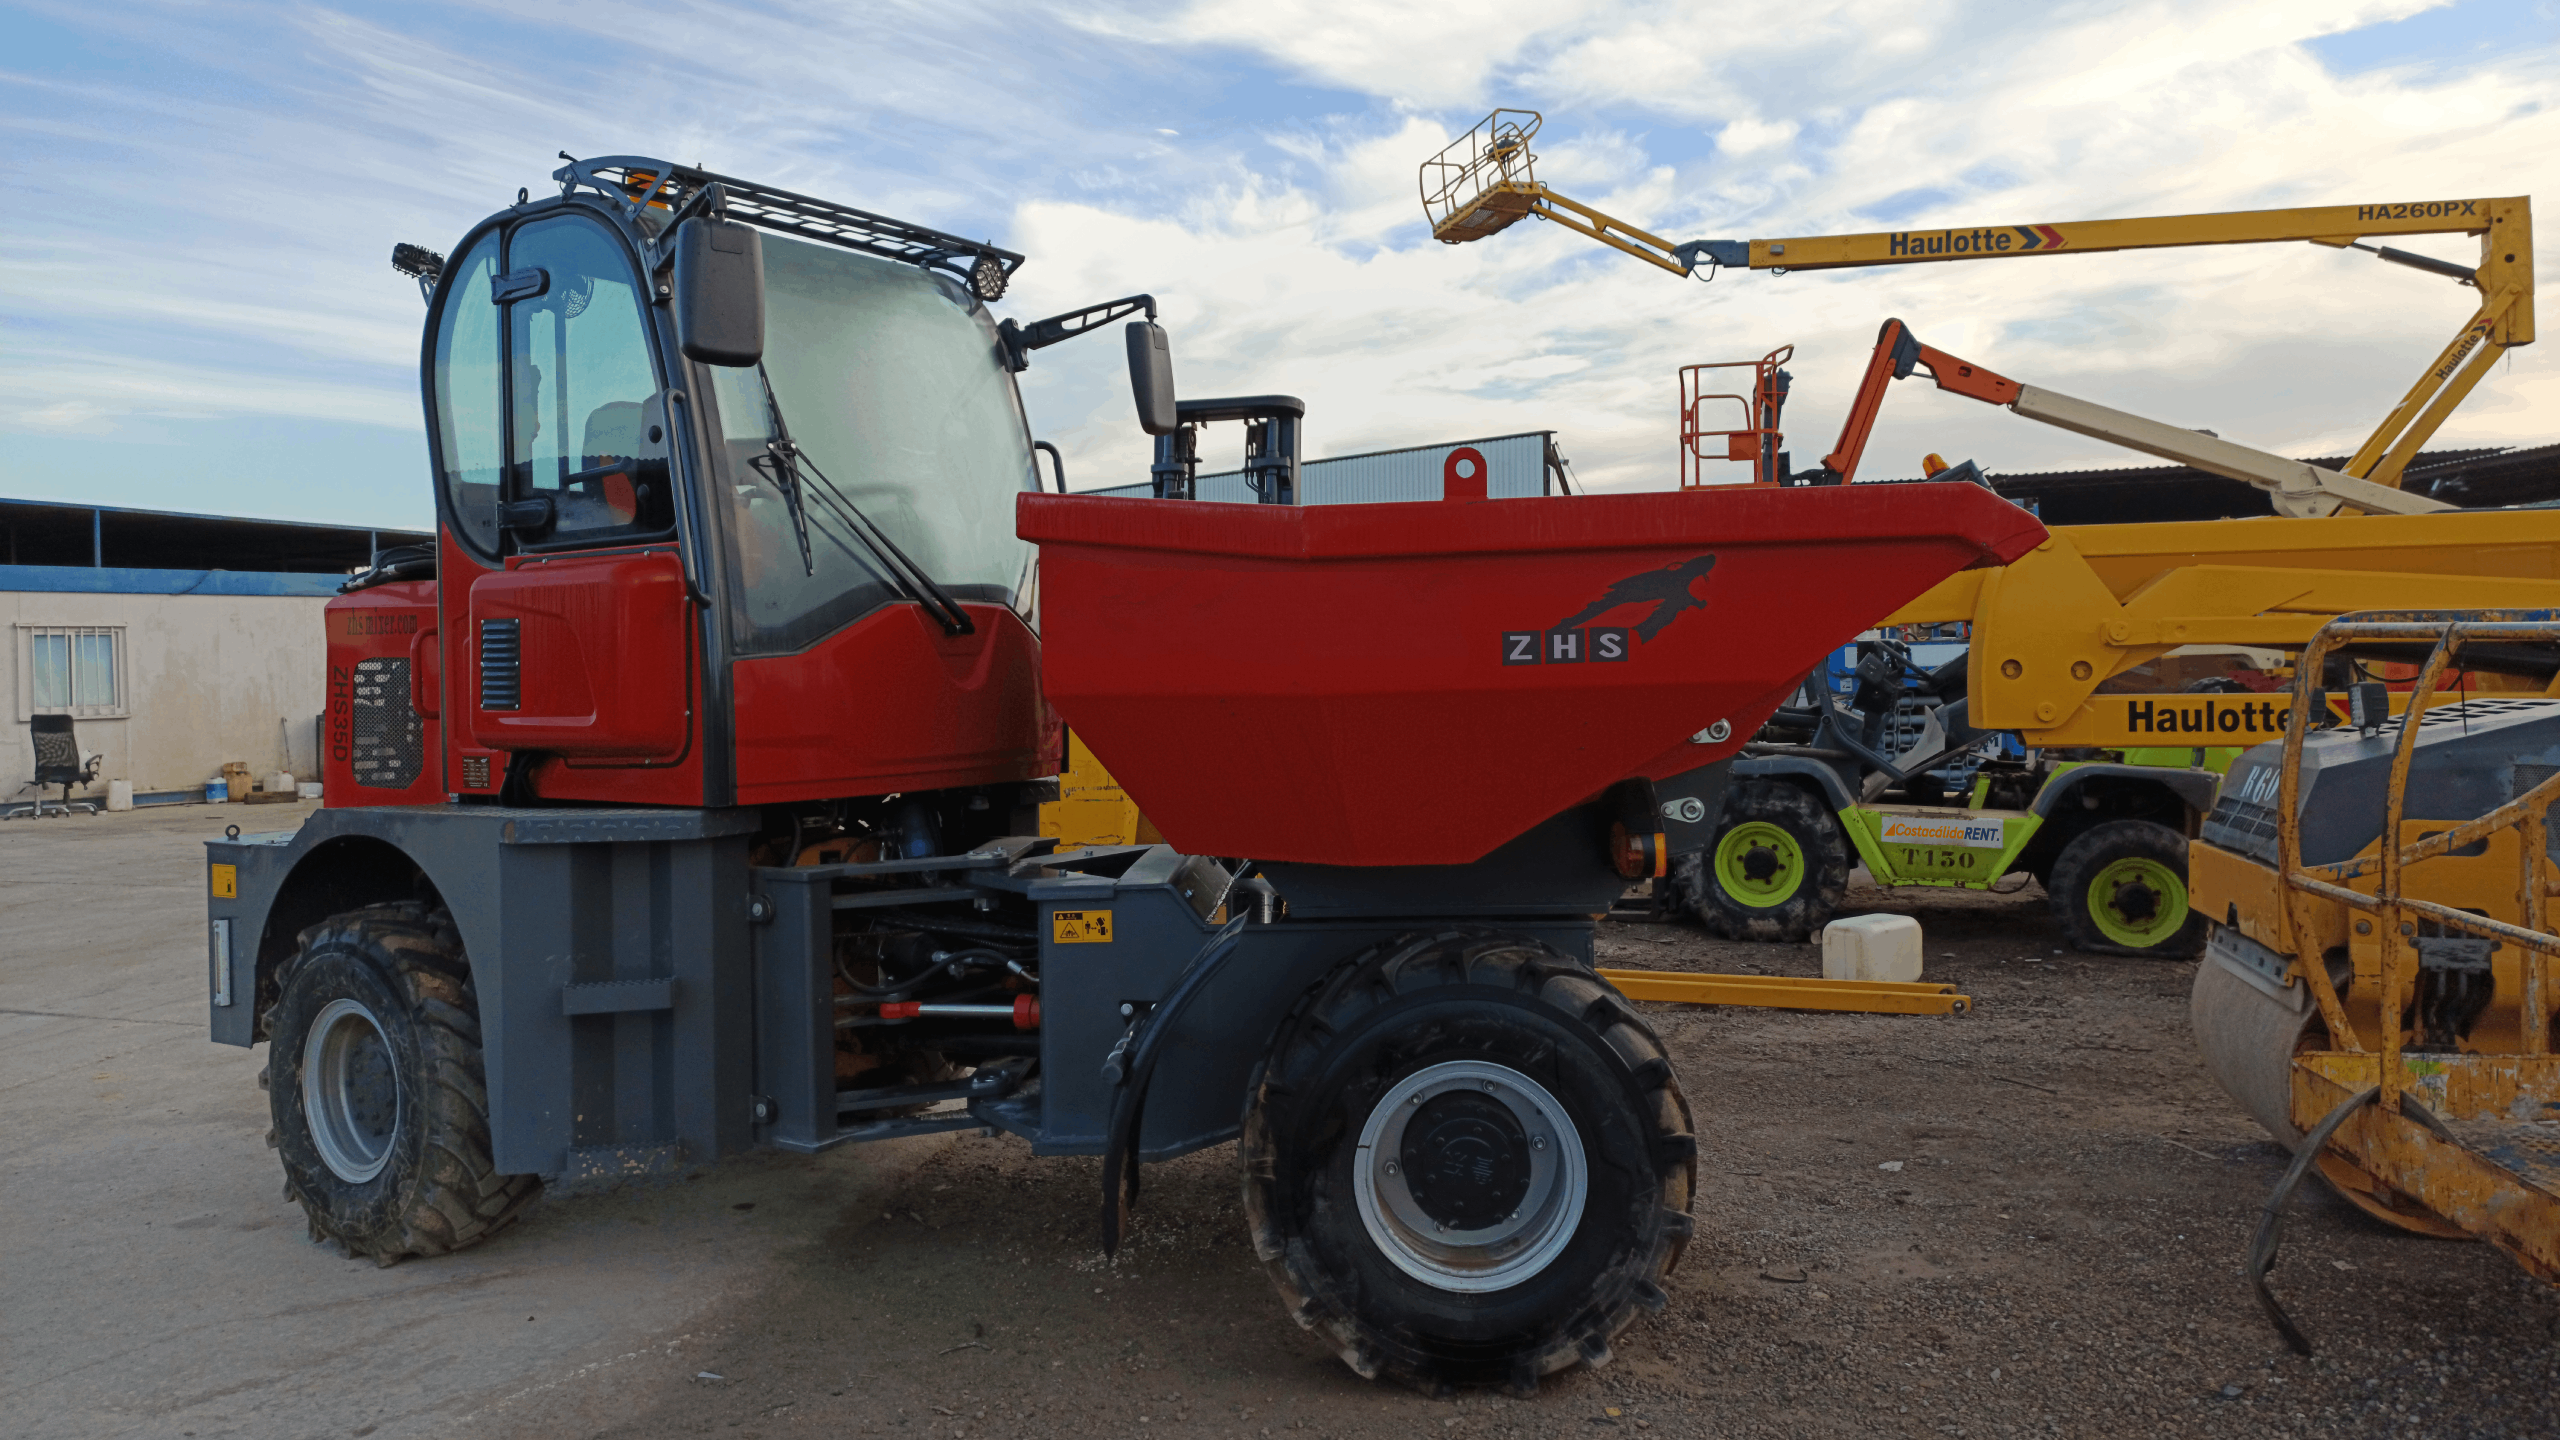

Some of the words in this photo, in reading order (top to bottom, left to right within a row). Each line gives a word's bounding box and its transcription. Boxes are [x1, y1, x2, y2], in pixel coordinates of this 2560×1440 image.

[2358, 200, 2477, 221] HA260PX
[1890, 229, 2012, 256] Haulotte
[2435, 335, 2478, 380] Haulotte
[1508, 632, 1622, 661] ZHS
[333, 665, 348, 762] ZHS35D
